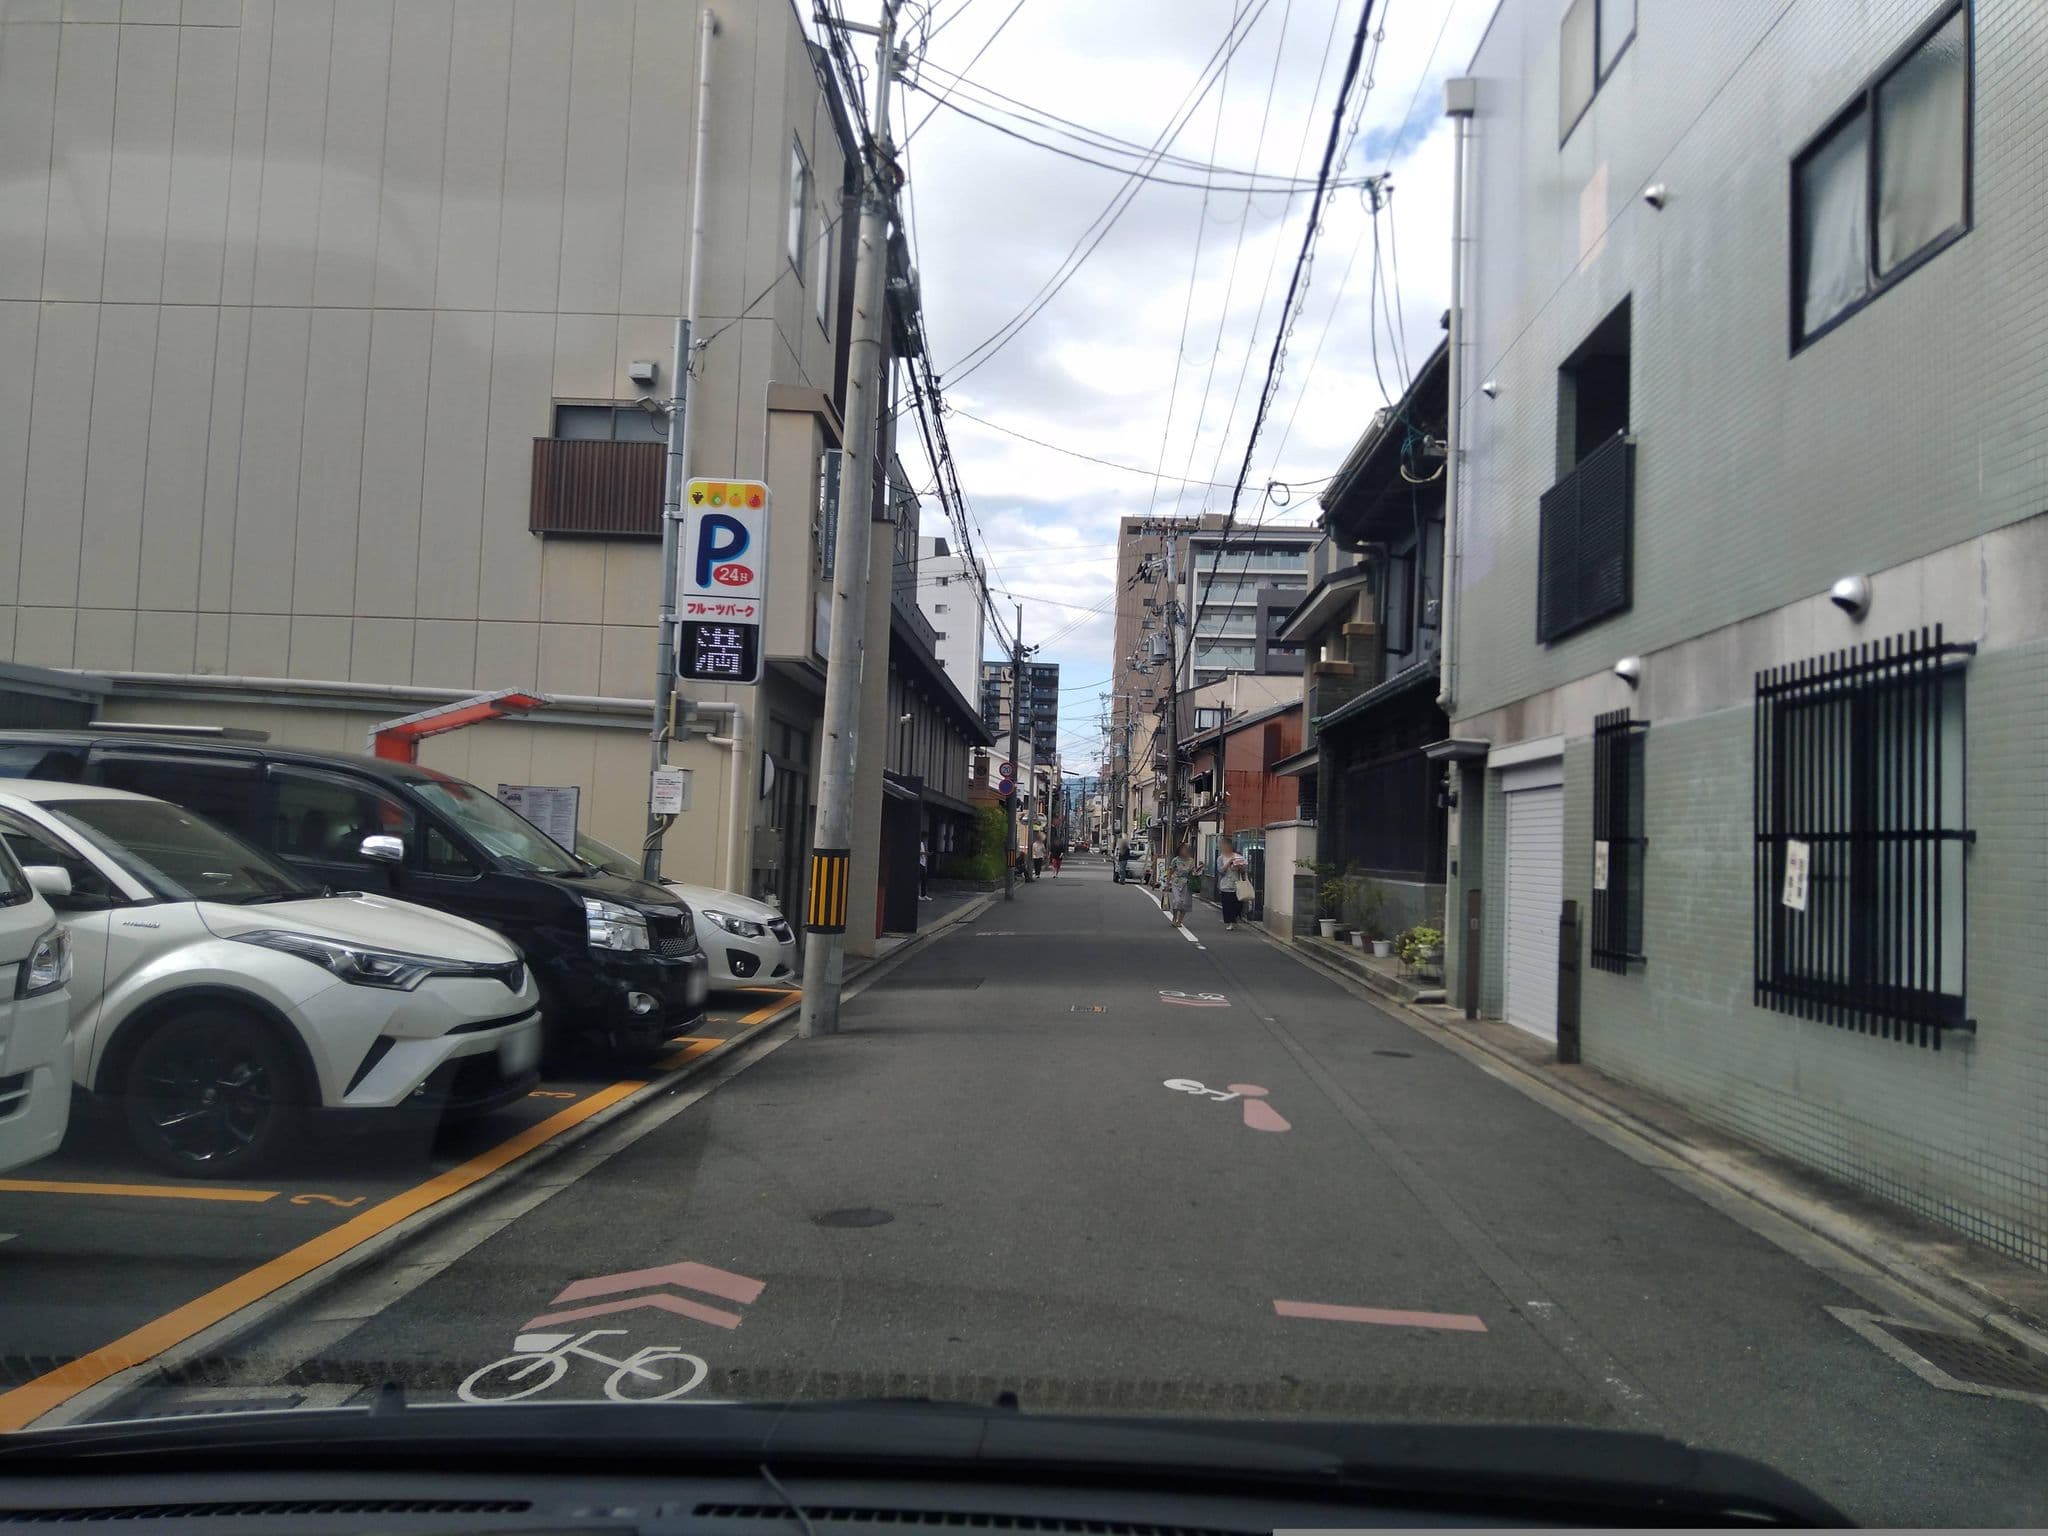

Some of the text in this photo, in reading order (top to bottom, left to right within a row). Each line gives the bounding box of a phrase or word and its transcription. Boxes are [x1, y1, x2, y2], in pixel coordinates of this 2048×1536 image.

[696, 514, 750, 588] P
[719, 567, 748, 582] 24H
[696, 627, 742, 673] 満
